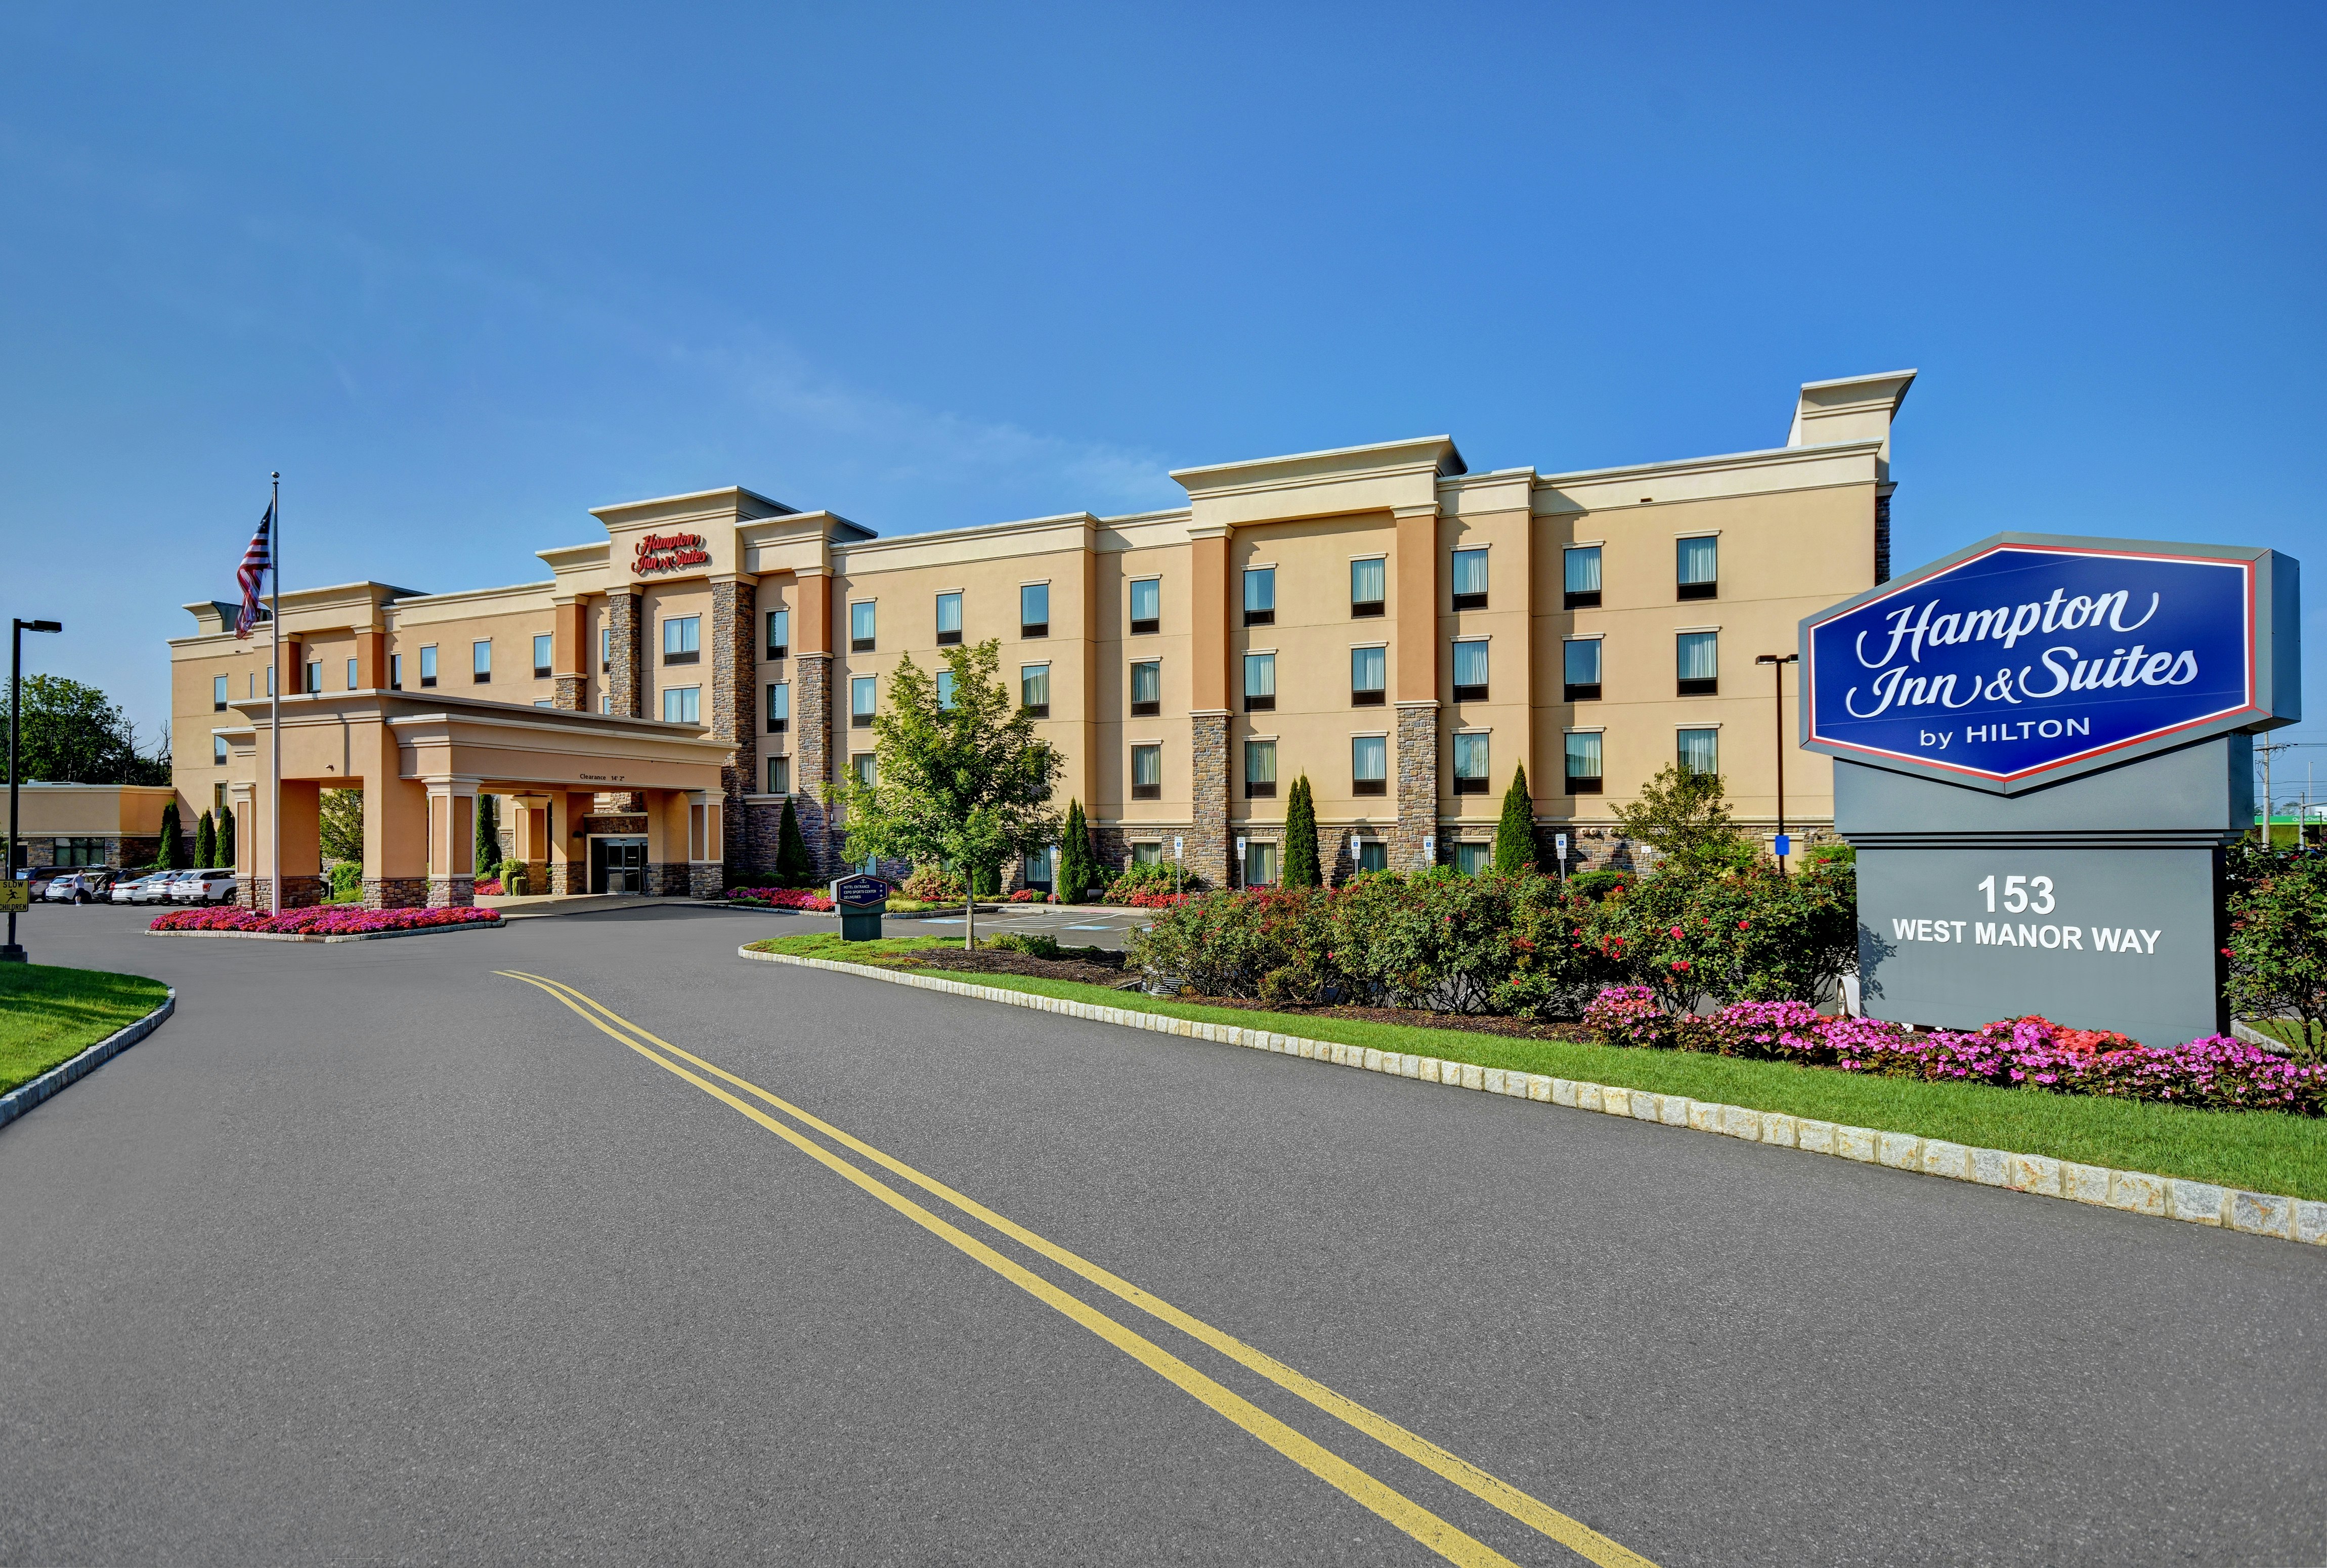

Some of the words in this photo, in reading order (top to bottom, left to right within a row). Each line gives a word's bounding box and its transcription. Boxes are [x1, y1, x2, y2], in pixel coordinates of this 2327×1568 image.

[631, 555, 664, 574] Inn
[663, 556, 671, 568] &
[670, 548, 708, 567] Suites
[635, 532, 701, 556] Hampton
[1857, 587, 2160, 668] Hampton
[1845, 665, 1983, 719] Inn
[1984, 668, 2022, 704] &
[2018, 644, 2199, 698] Suites
[1920, 729, 1954, 750] by
[1966, 717, 2090, 744] HILTON
[1978, 875, 2056, 914] 153
[1891, 918, 1967, 944] WEST
[1974, 922, 2084, 950] MANOR
[2090, 927, 2162, 954] WAY
